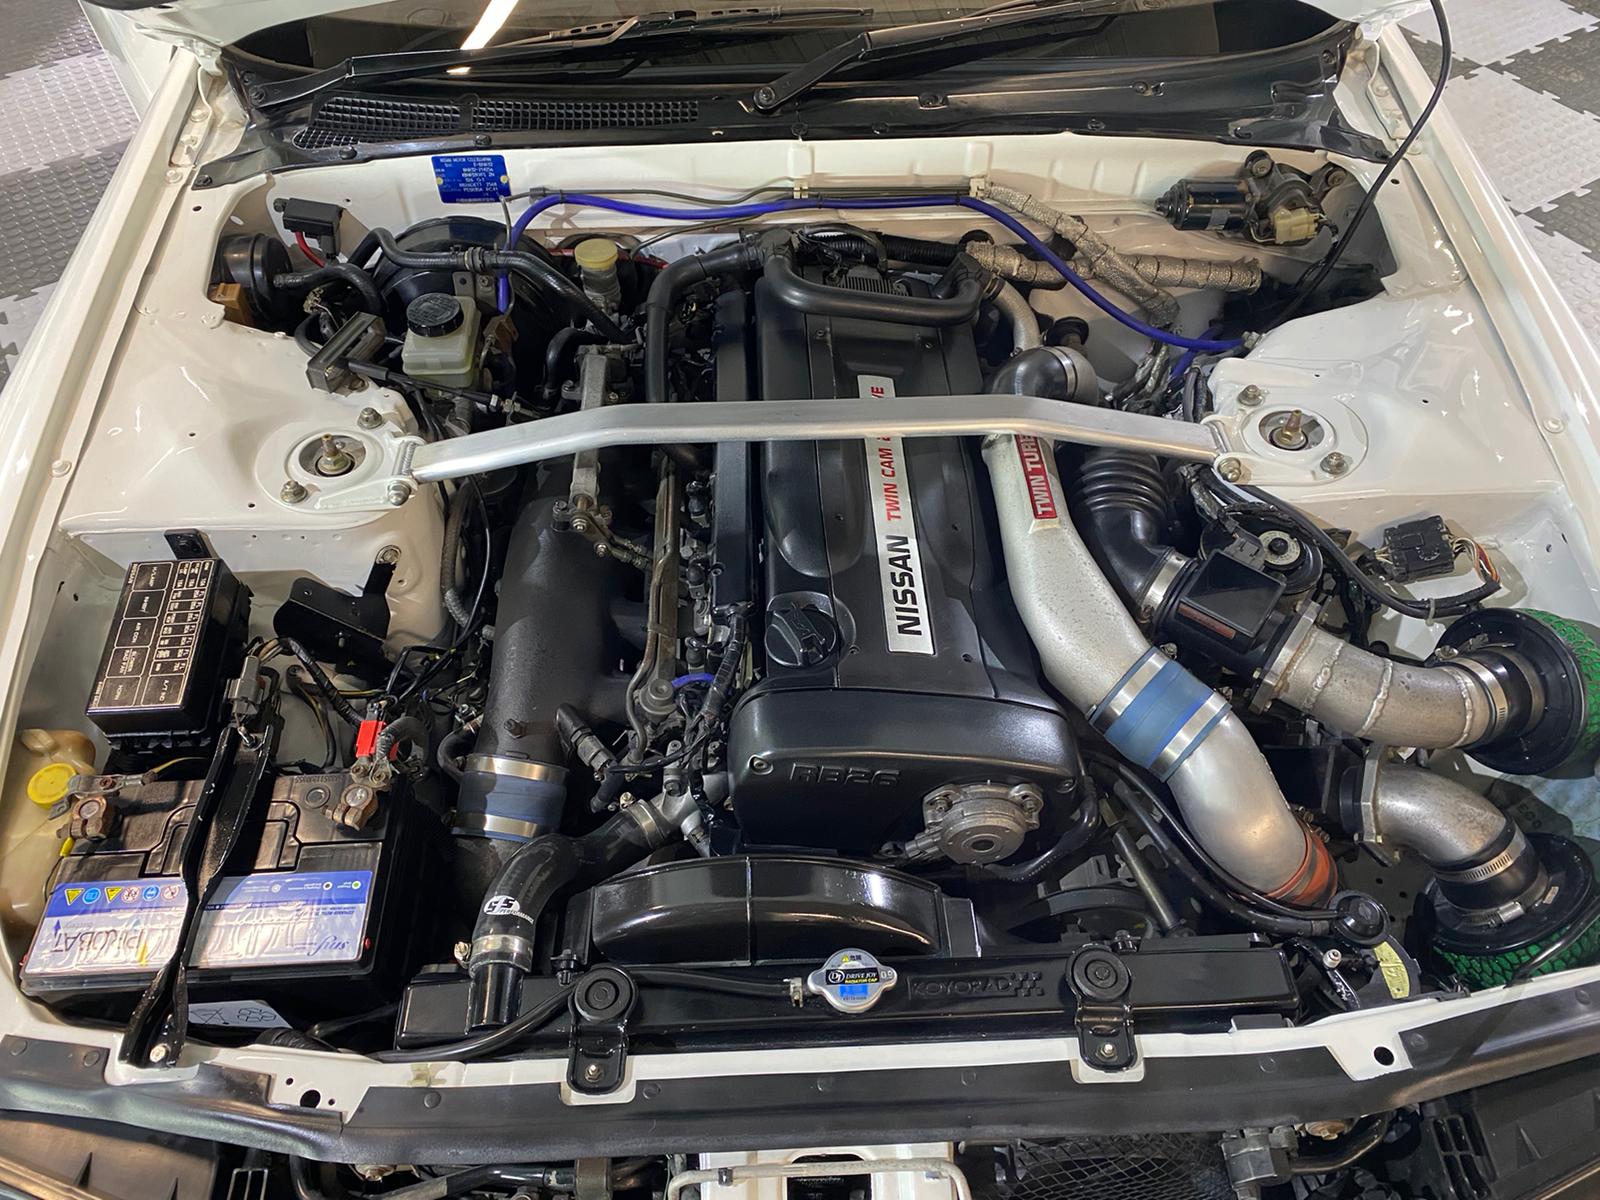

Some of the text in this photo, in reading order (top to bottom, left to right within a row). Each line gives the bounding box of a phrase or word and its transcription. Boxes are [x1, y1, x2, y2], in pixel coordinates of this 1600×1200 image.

[878, 447, 896, 479] CAM
[1020, 434, 1053, 515] TWIN TURB
[882, 482, 902, 521] TWIN
[885, 534, 923, 637] NISSAN
[789, 762, 900, 786] RB26
